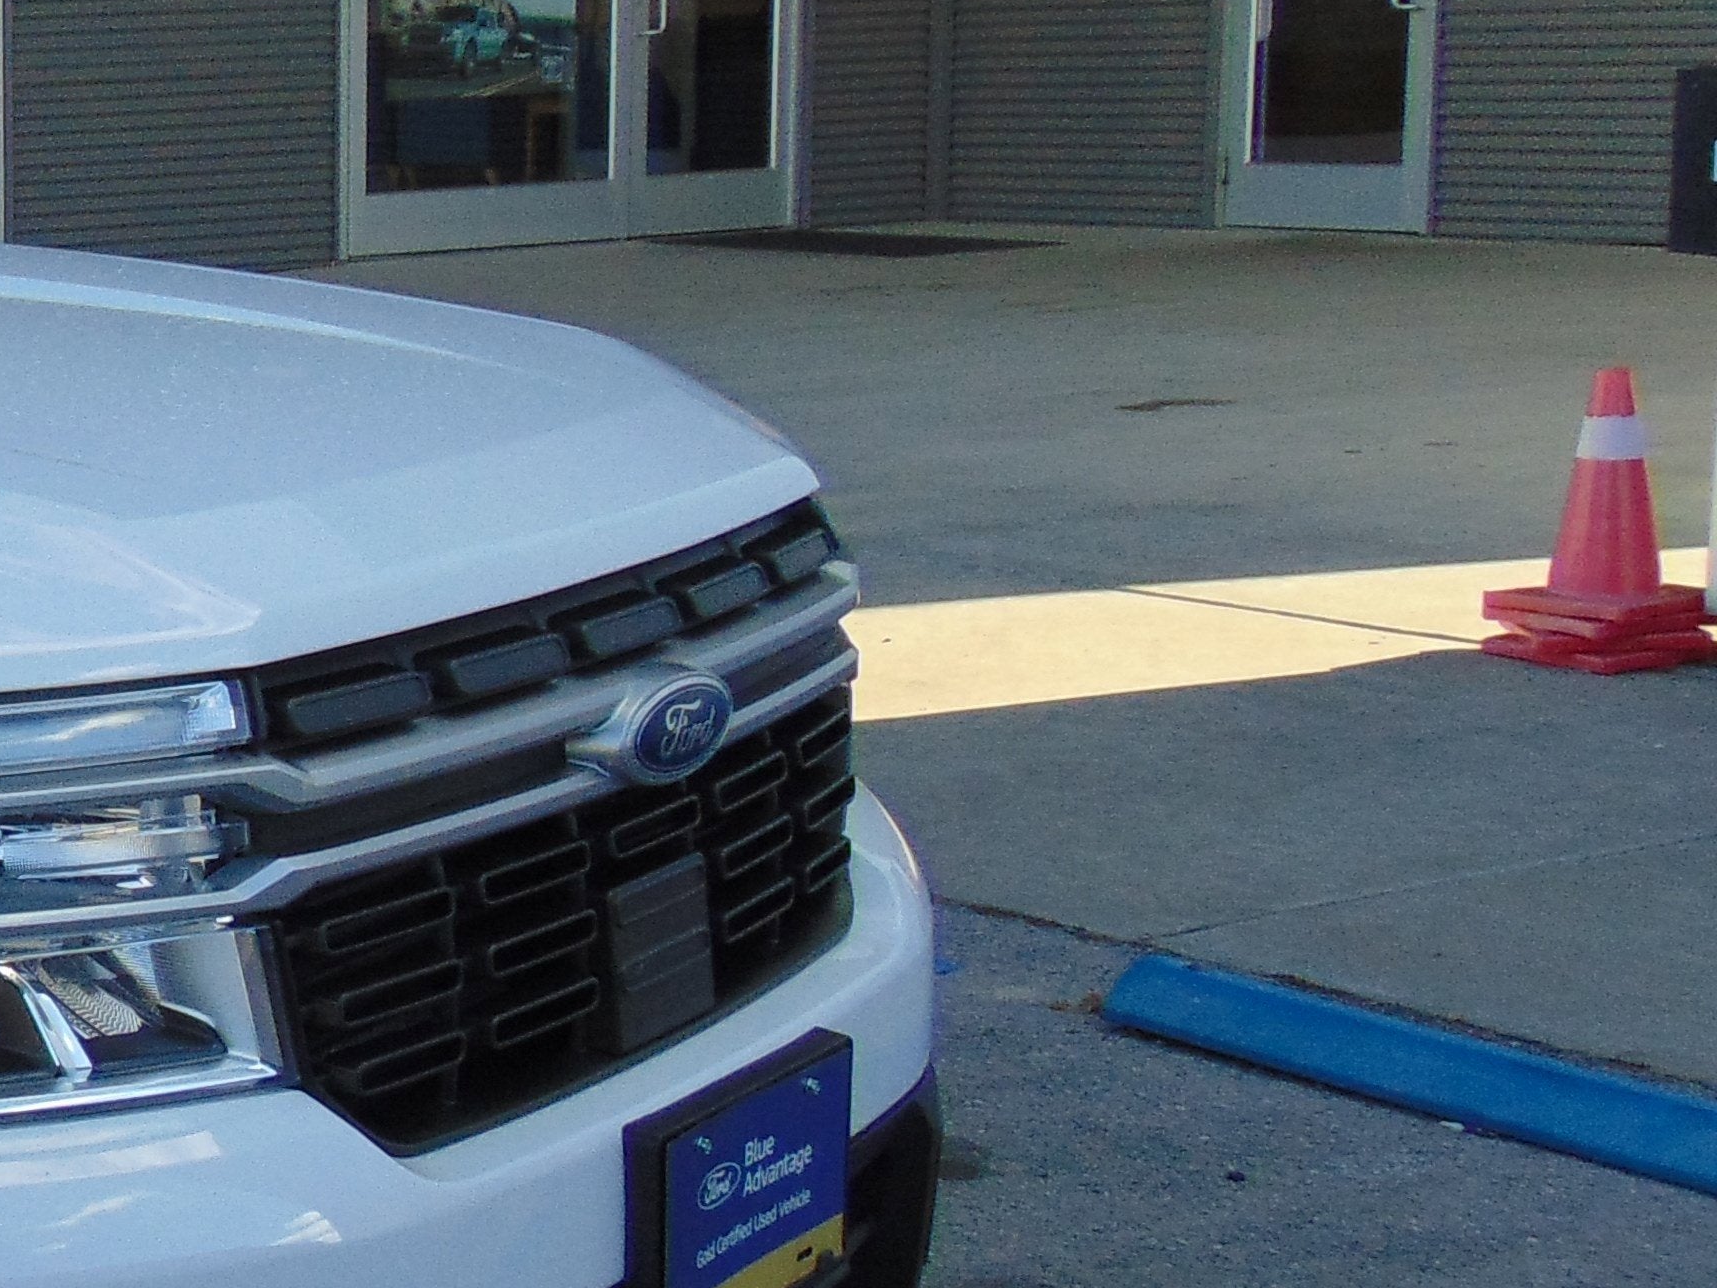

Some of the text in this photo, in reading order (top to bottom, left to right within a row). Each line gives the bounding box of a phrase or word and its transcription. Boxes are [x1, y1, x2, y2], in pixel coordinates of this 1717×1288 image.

[660, 698, 717, 757] Ford
[743, 1145, 813, 1197] Advantage
[745, 1136, 775, 1166] Blue
[704, 1169, 734, 1206] Ford
[696, 1189, 811, 1270] Gold Certified Used Vehicle
